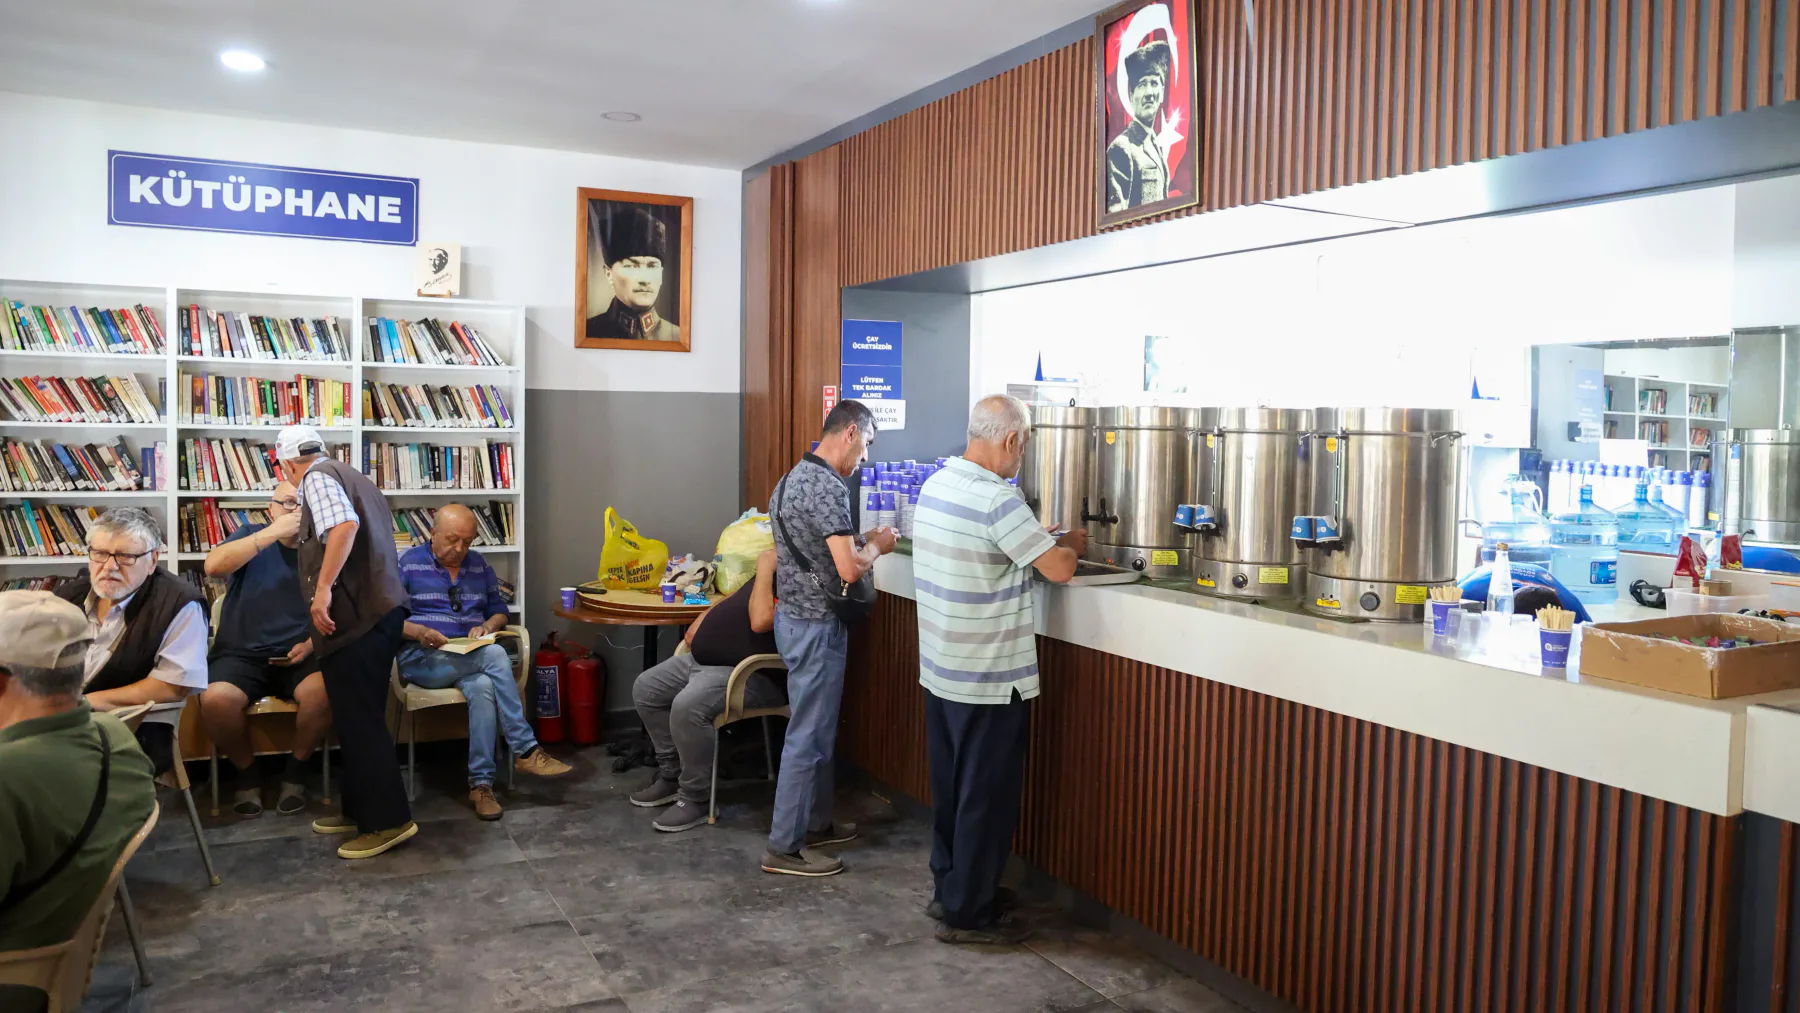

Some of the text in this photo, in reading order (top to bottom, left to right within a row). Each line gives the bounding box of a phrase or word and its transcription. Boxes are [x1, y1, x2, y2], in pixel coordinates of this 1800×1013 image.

[129, 169, 402, 224] KÜTÜPHANE
[852, 342, 892, 350] ÜCRETSİZDİR
[628, 563, 653, 576] KAPINA
